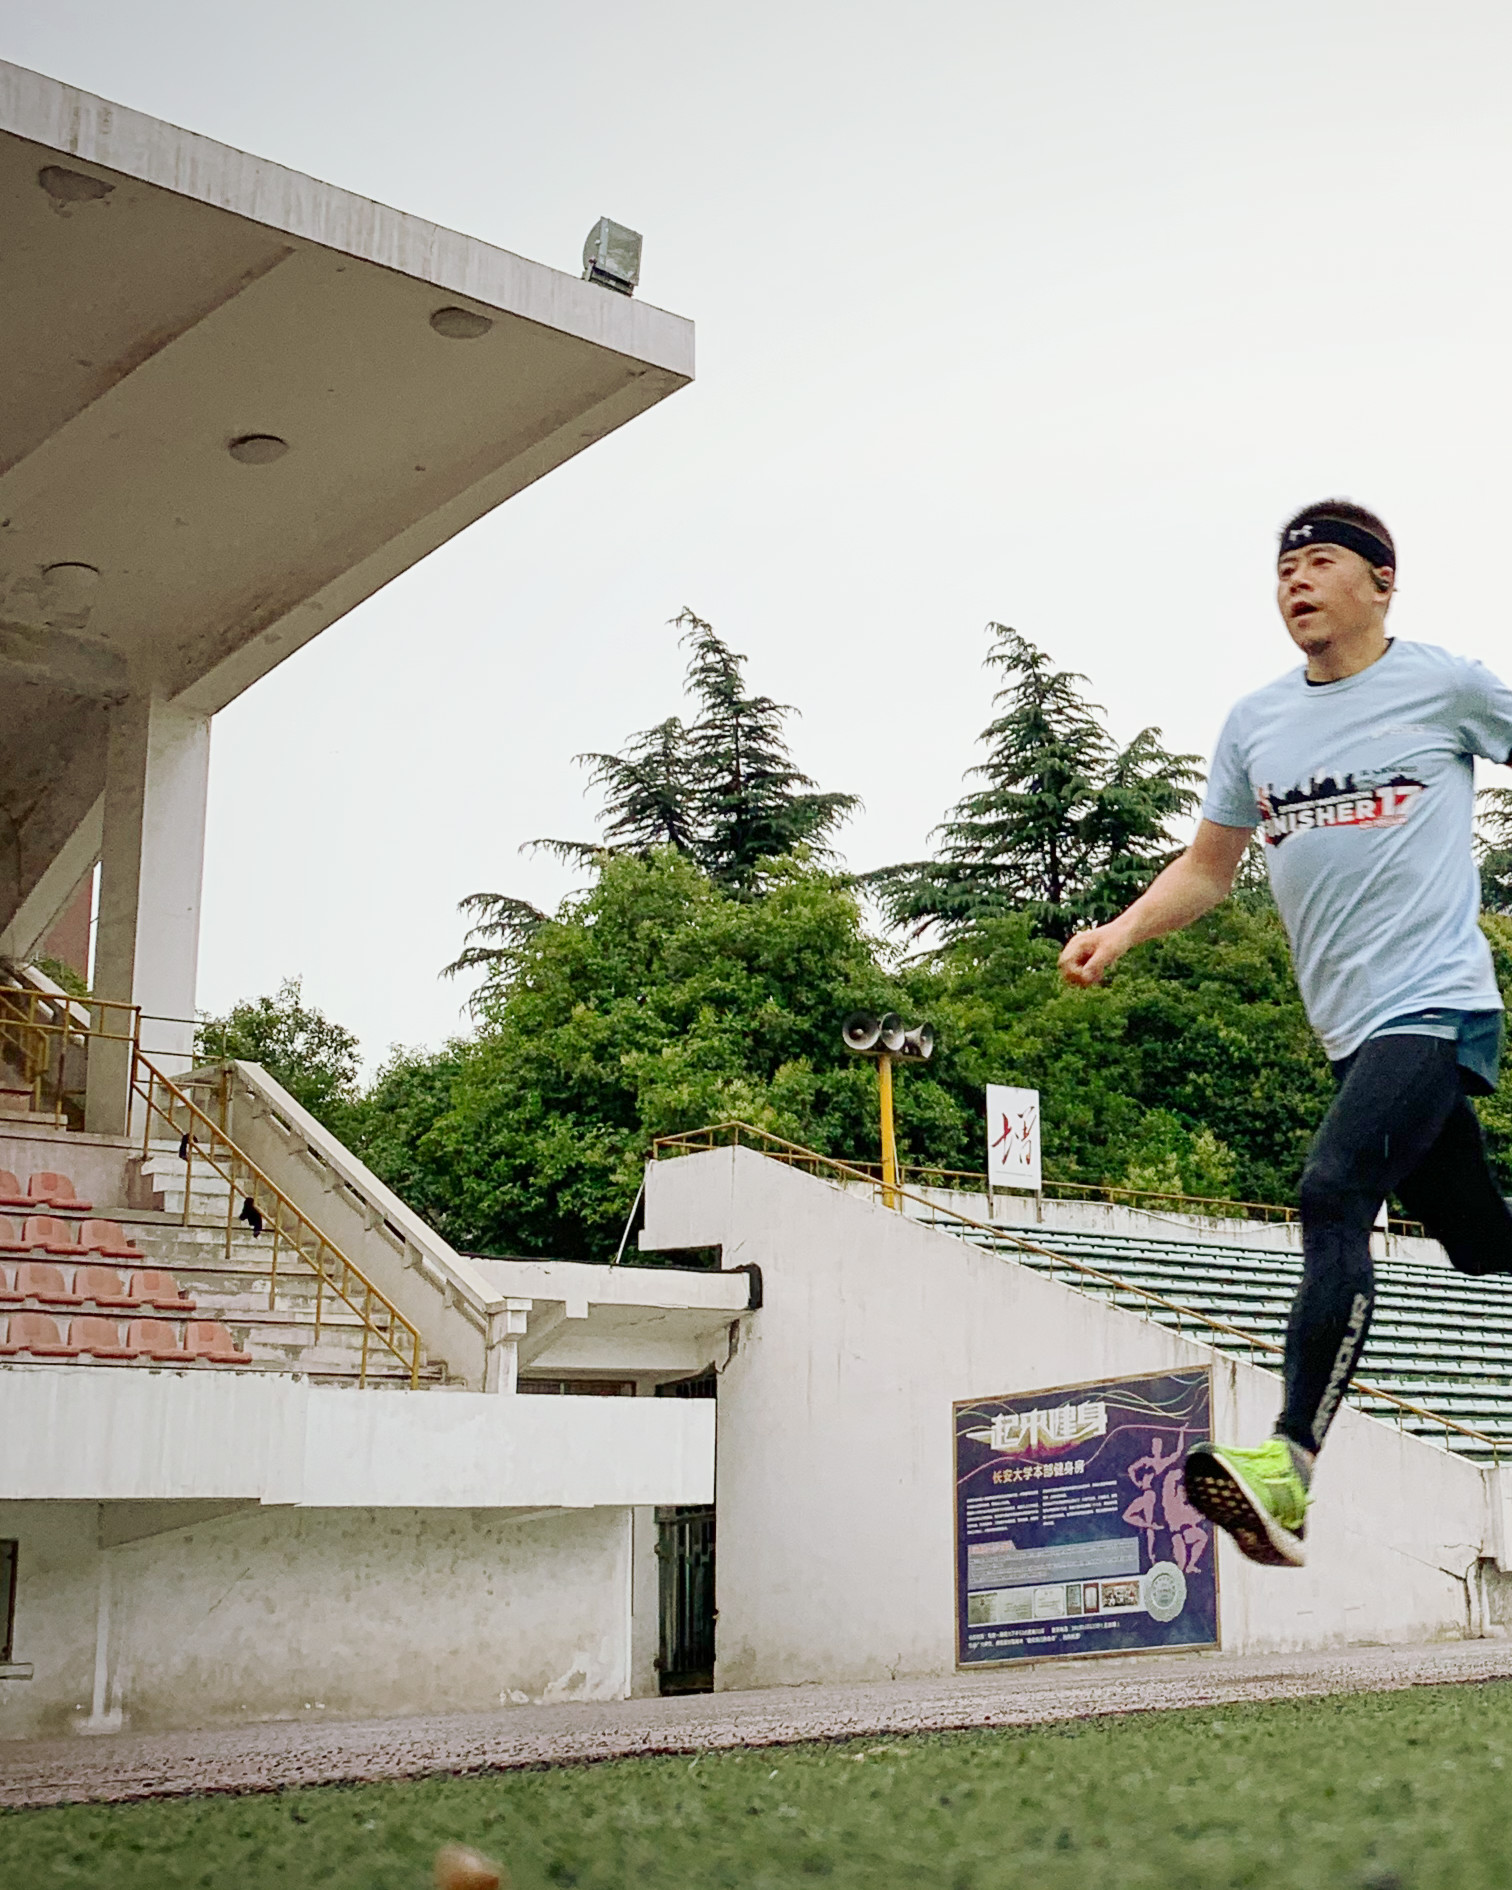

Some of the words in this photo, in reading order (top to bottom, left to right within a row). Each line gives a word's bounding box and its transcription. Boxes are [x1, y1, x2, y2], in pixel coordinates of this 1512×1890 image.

[1260, 798, 1377, 837] NISHER
[1376, 785, 1422, 817] 17
[1311, 1292, 1371, 1446] ARMOUR
[966, 1400, 1109, 1450] 一起来健身
[992, 1459, 1086, 1485] 长安大学本部健身房
